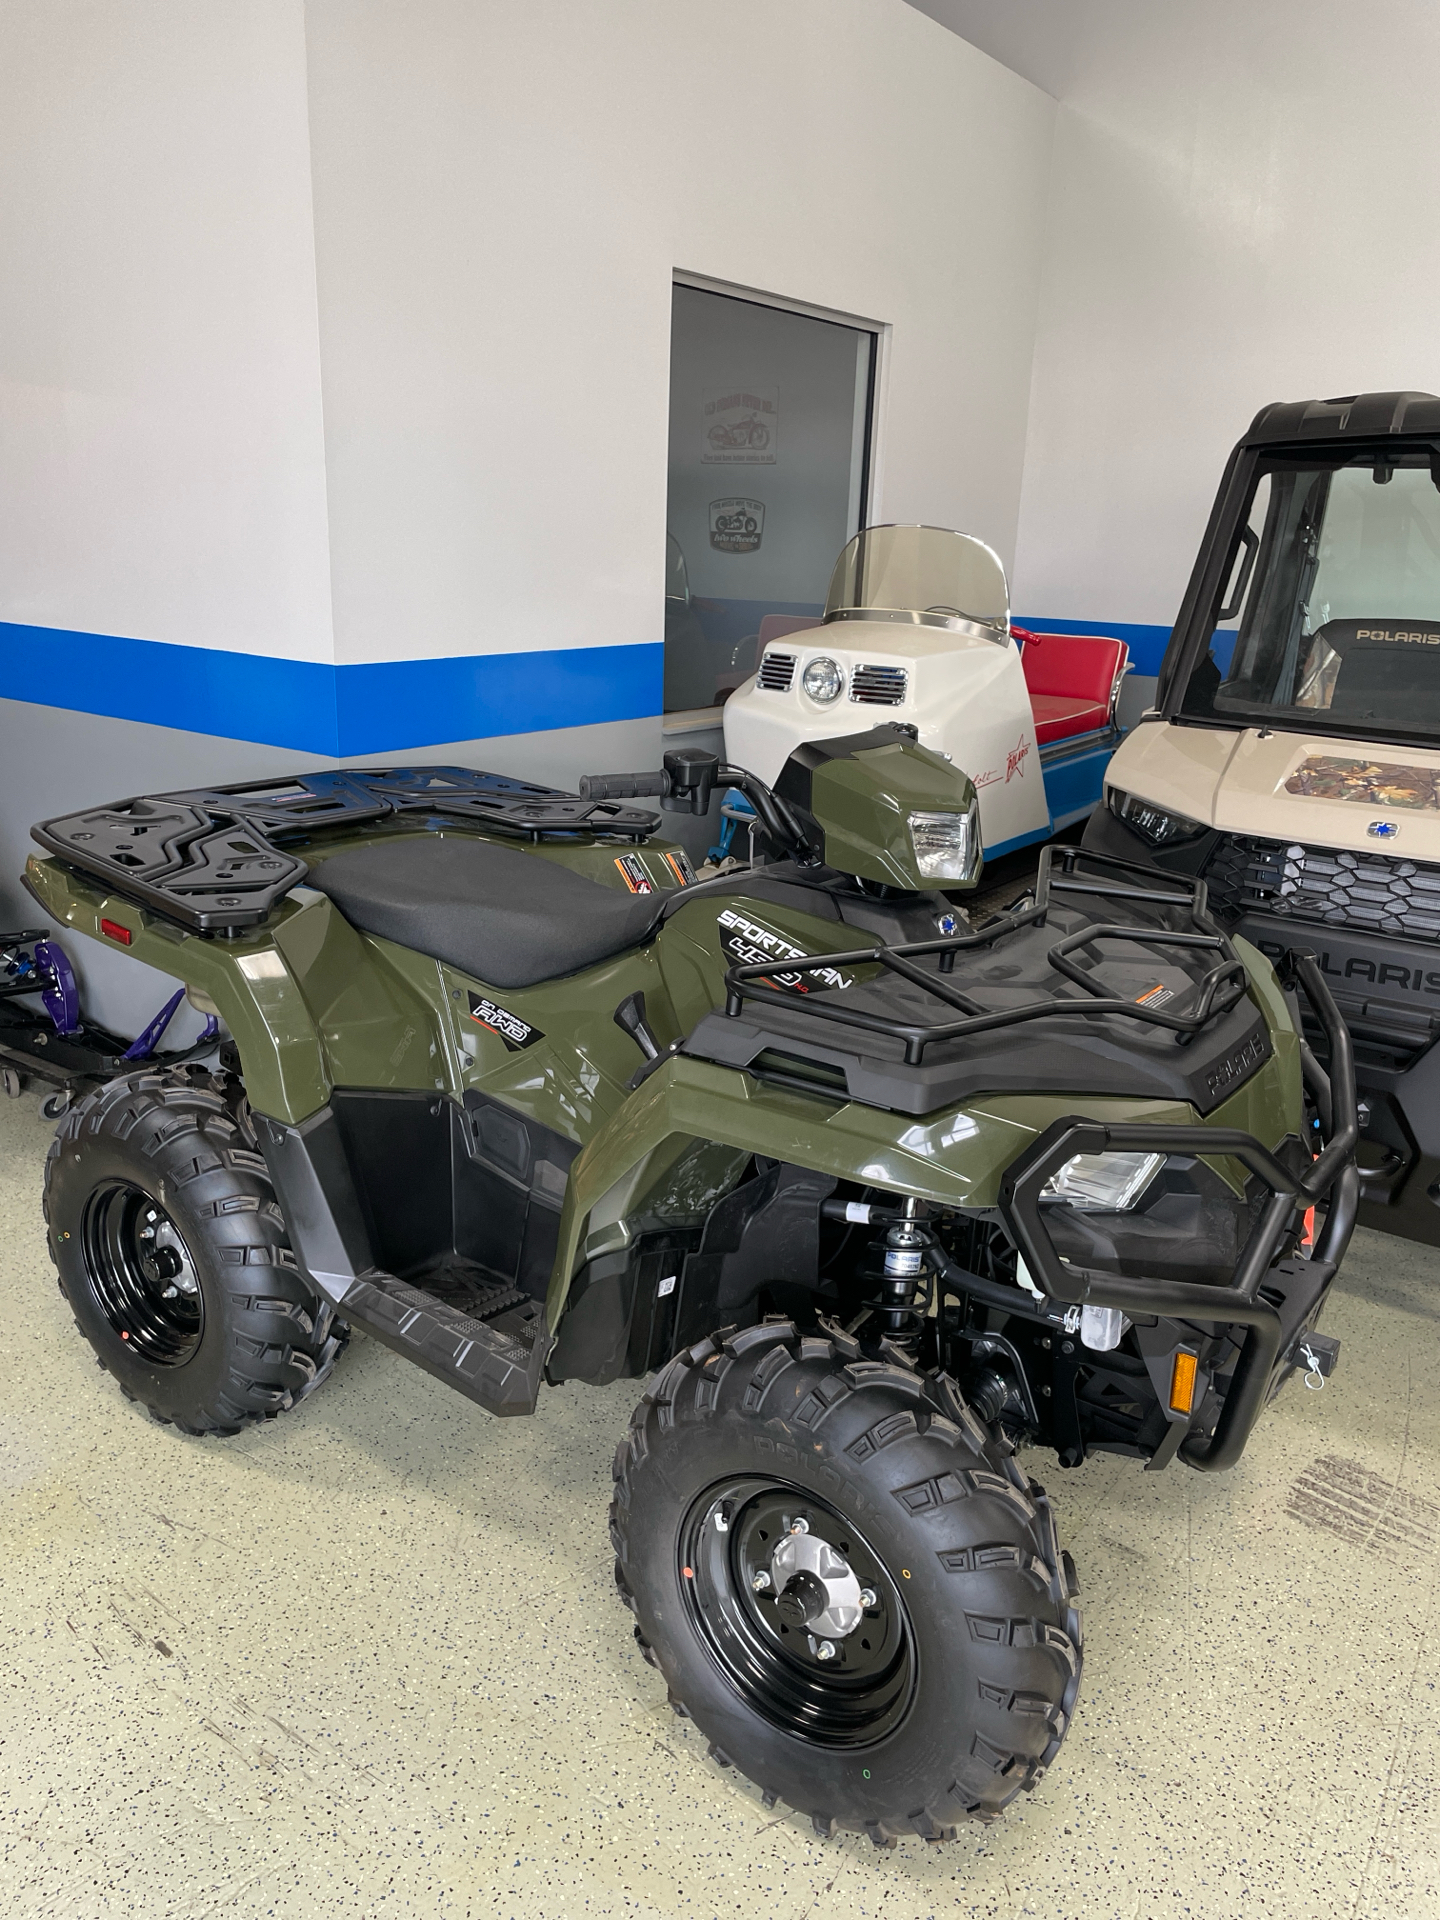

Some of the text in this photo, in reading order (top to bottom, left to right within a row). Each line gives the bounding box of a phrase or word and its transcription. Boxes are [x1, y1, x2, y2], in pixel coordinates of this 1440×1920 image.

[1356, 629, 1440, 645] POLARIS
[716, 909, 853, 990] SPORTSAN
[1256, 938, 1440, 994] PLARIS
[472, 1004, 528, 1042] AWD
[1204, 1032, 1265, 1097] POLARIS
[887, 1250, 920, 1263] POLARIS
